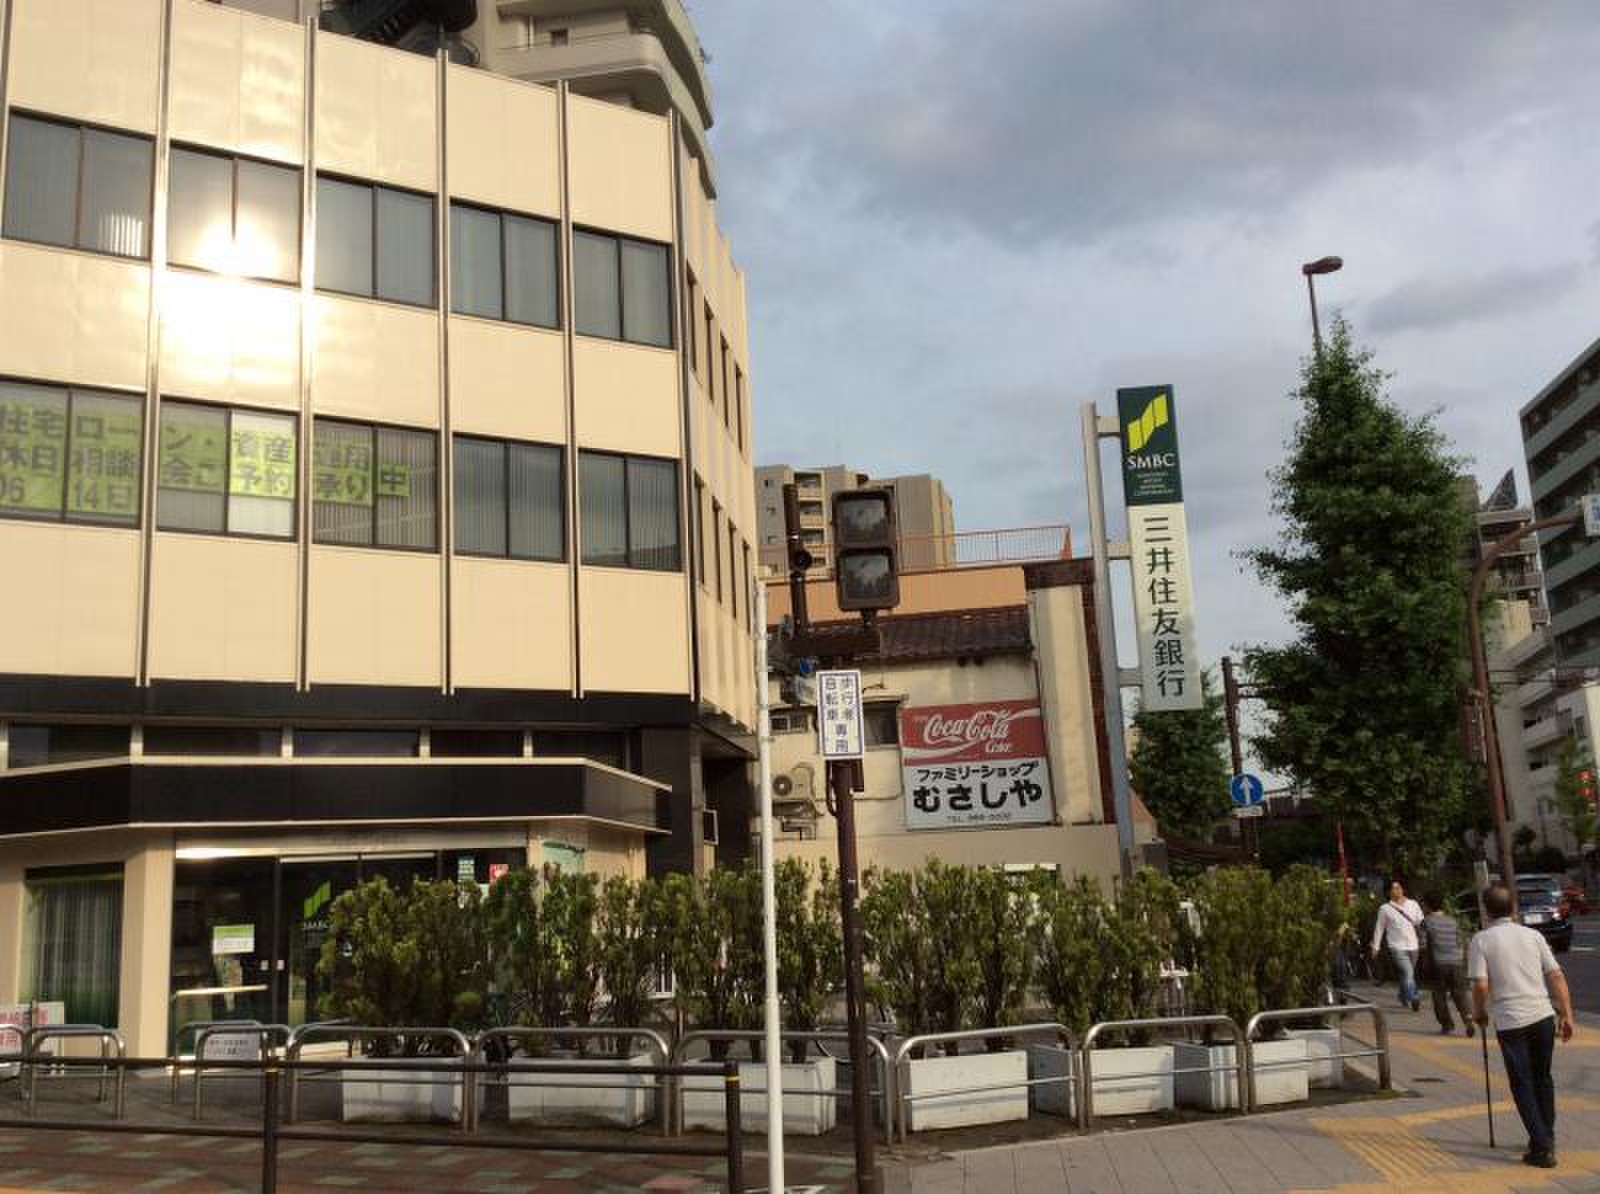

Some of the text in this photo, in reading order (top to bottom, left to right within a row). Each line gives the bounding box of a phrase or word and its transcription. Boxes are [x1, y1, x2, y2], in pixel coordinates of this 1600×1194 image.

[1125, 452, 1176, 470] SMBC
[1143, 515, 1186, 697] 三井住友銀行
[825, 677, 839, 721] 自転車
[835, 723, 849, 753] 専用
[917, 760, 1040, 782] ファミリーショップ
[913, 778, 1043, 813] むさしや
